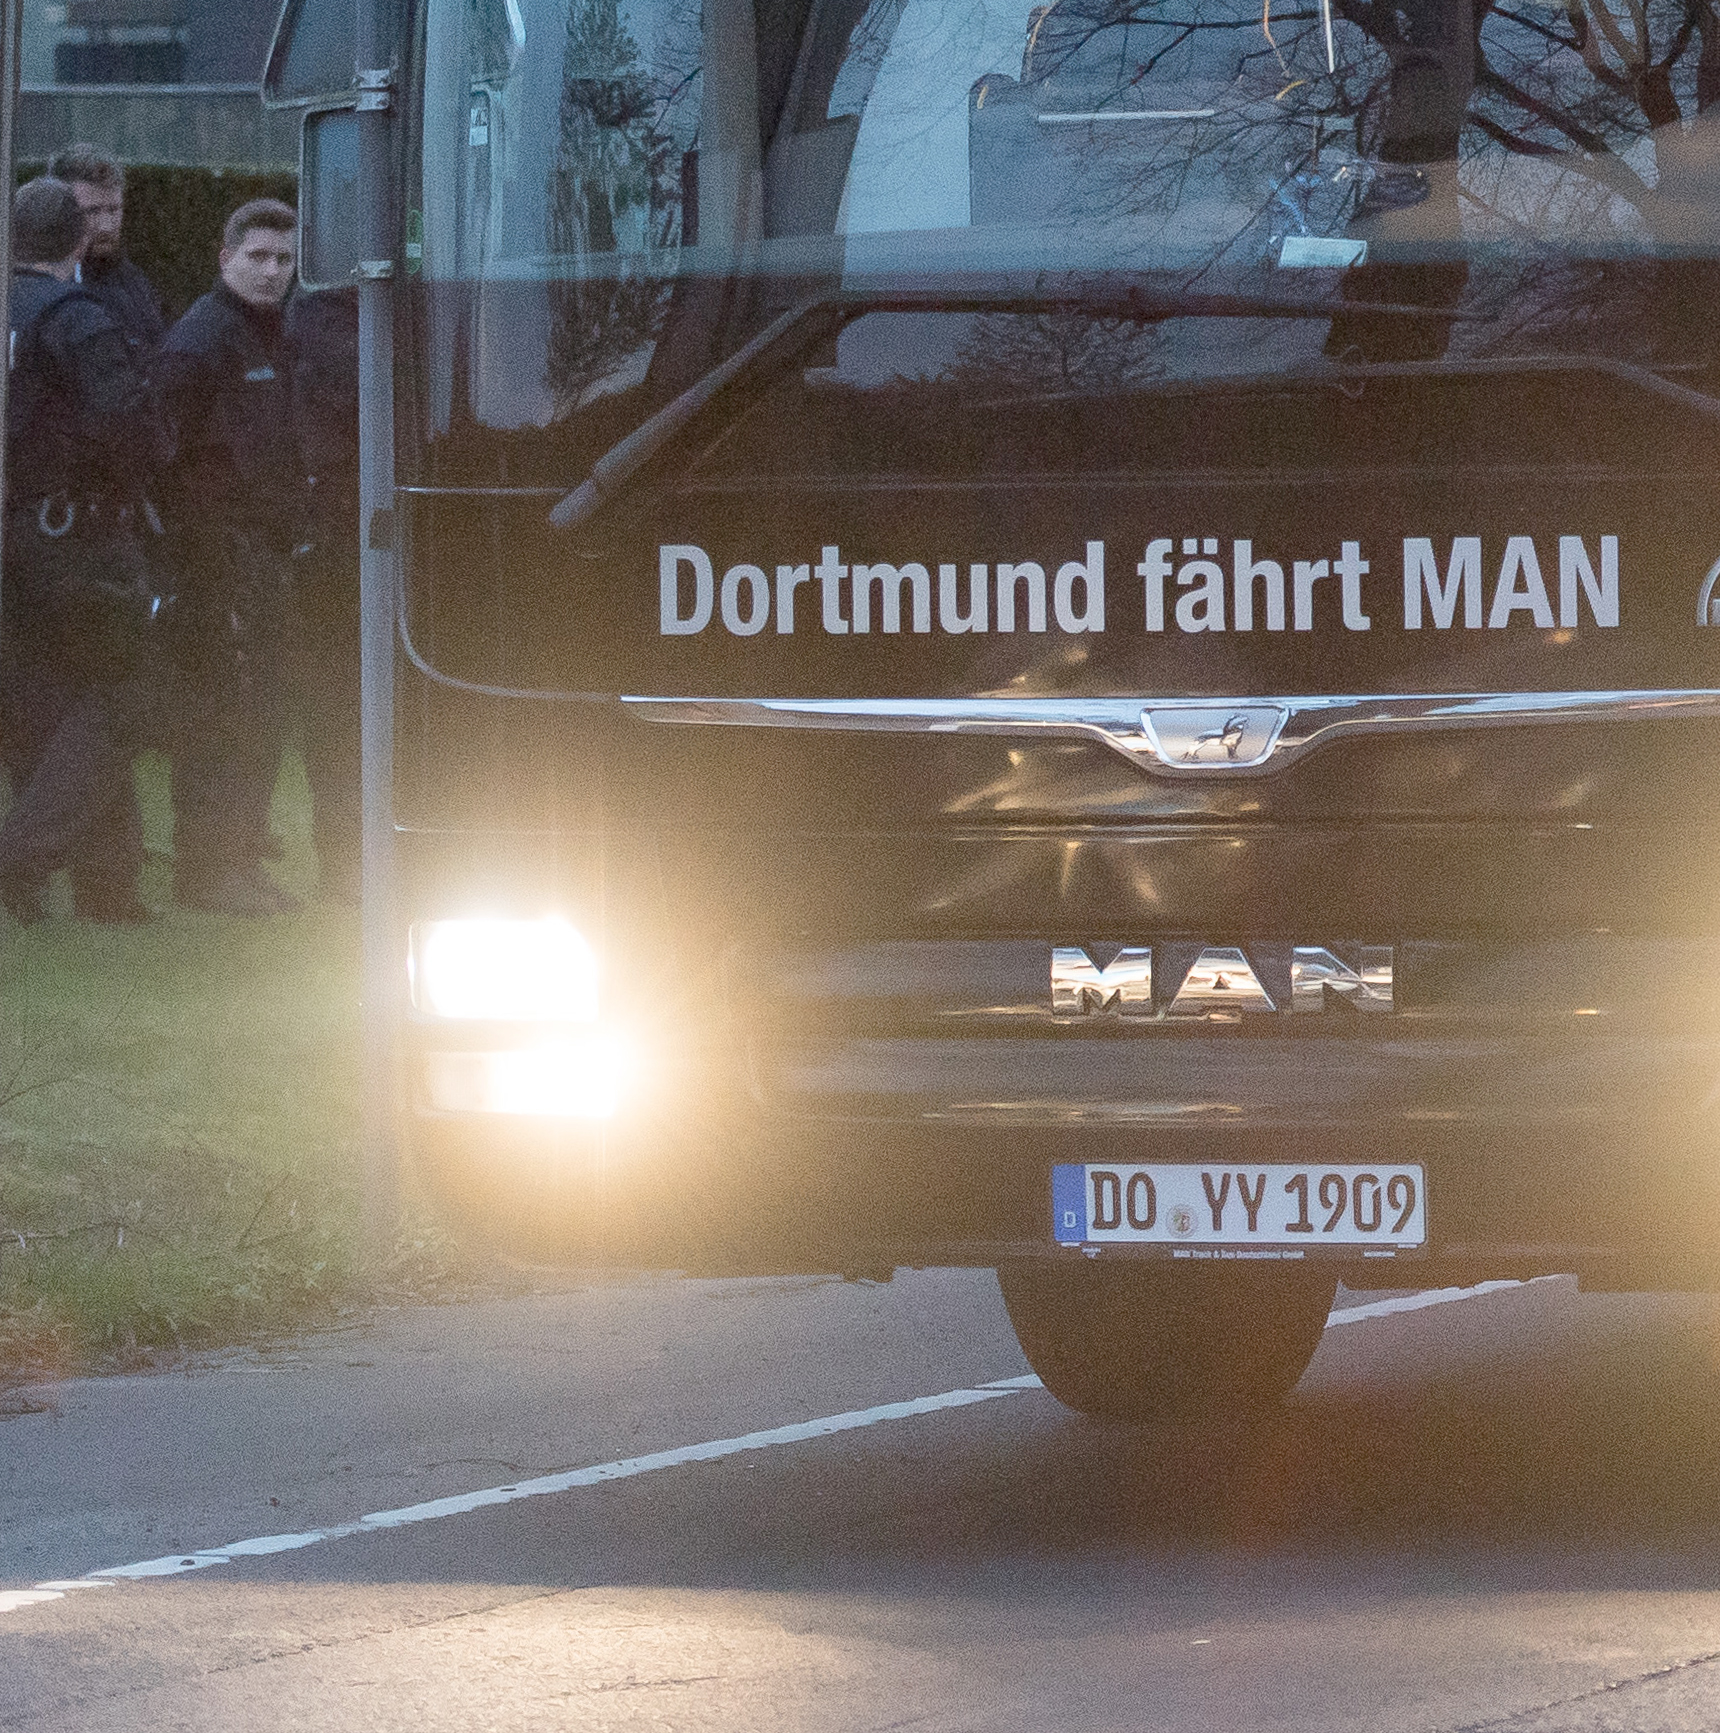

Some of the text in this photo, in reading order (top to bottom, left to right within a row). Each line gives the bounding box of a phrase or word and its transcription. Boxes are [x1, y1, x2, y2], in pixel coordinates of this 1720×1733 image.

[657, 533, 1624, 638] Dortmund fährt MAN
[1051, 946, 1394, 1016] MAN
[1063, 1210, 1078, 1229] D
[1090, 1170, 1417, 1234] DO YY 1909
